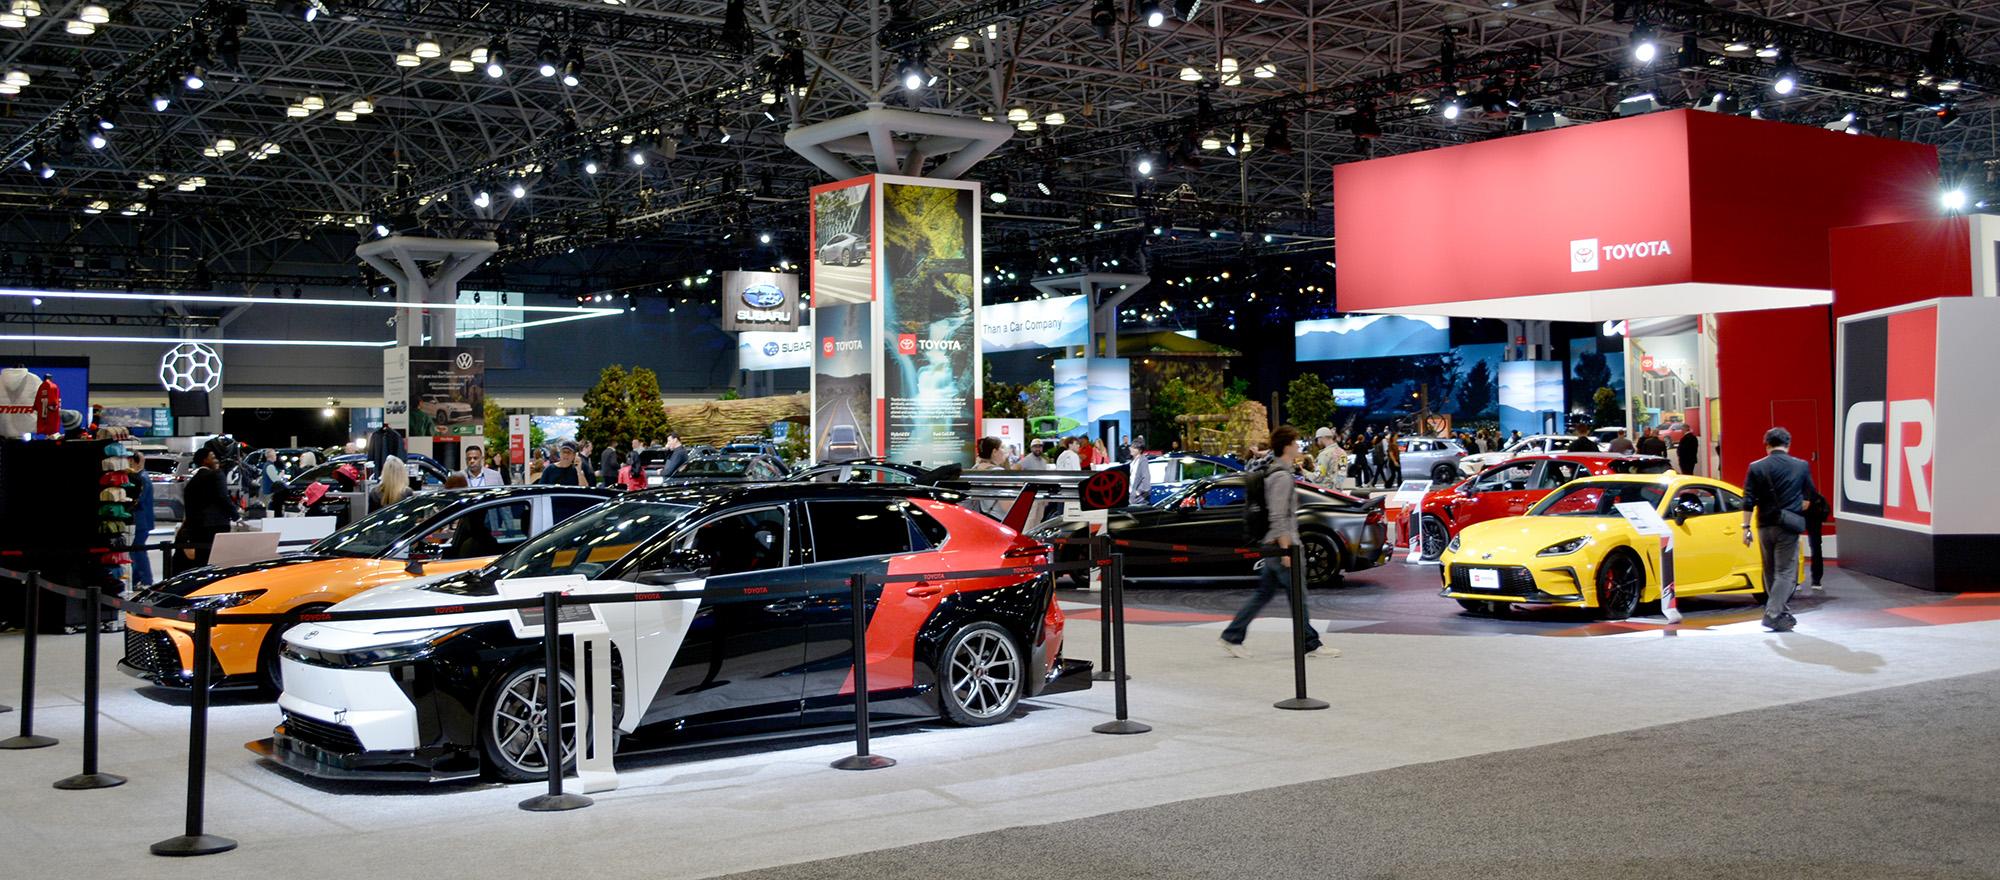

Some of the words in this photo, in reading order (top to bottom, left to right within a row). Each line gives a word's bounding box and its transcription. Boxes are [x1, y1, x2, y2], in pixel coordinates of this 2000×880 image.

[1602, 240, 1671, 261] TOYOTA
[736, 310, 791, 322] SUBARU
[983, 324, 1001, 334] Than
[1003, 325, 1008, 333] a
[1009, 321, 1023, 332] Car
[1024, 319, 1062, 331] Company
[781, 341, 812, 353] SUBAR
[836, 339, 863, 351] TOYOTA
[918, 339, 961, 351] TOYOTA
[0, 405, 34, 414] OYOTA
[1843, 398, 1934, 512] GR
[434, 606, 464, 614] TOYOTA
[299, 613, 332, 621] TOYOTA
